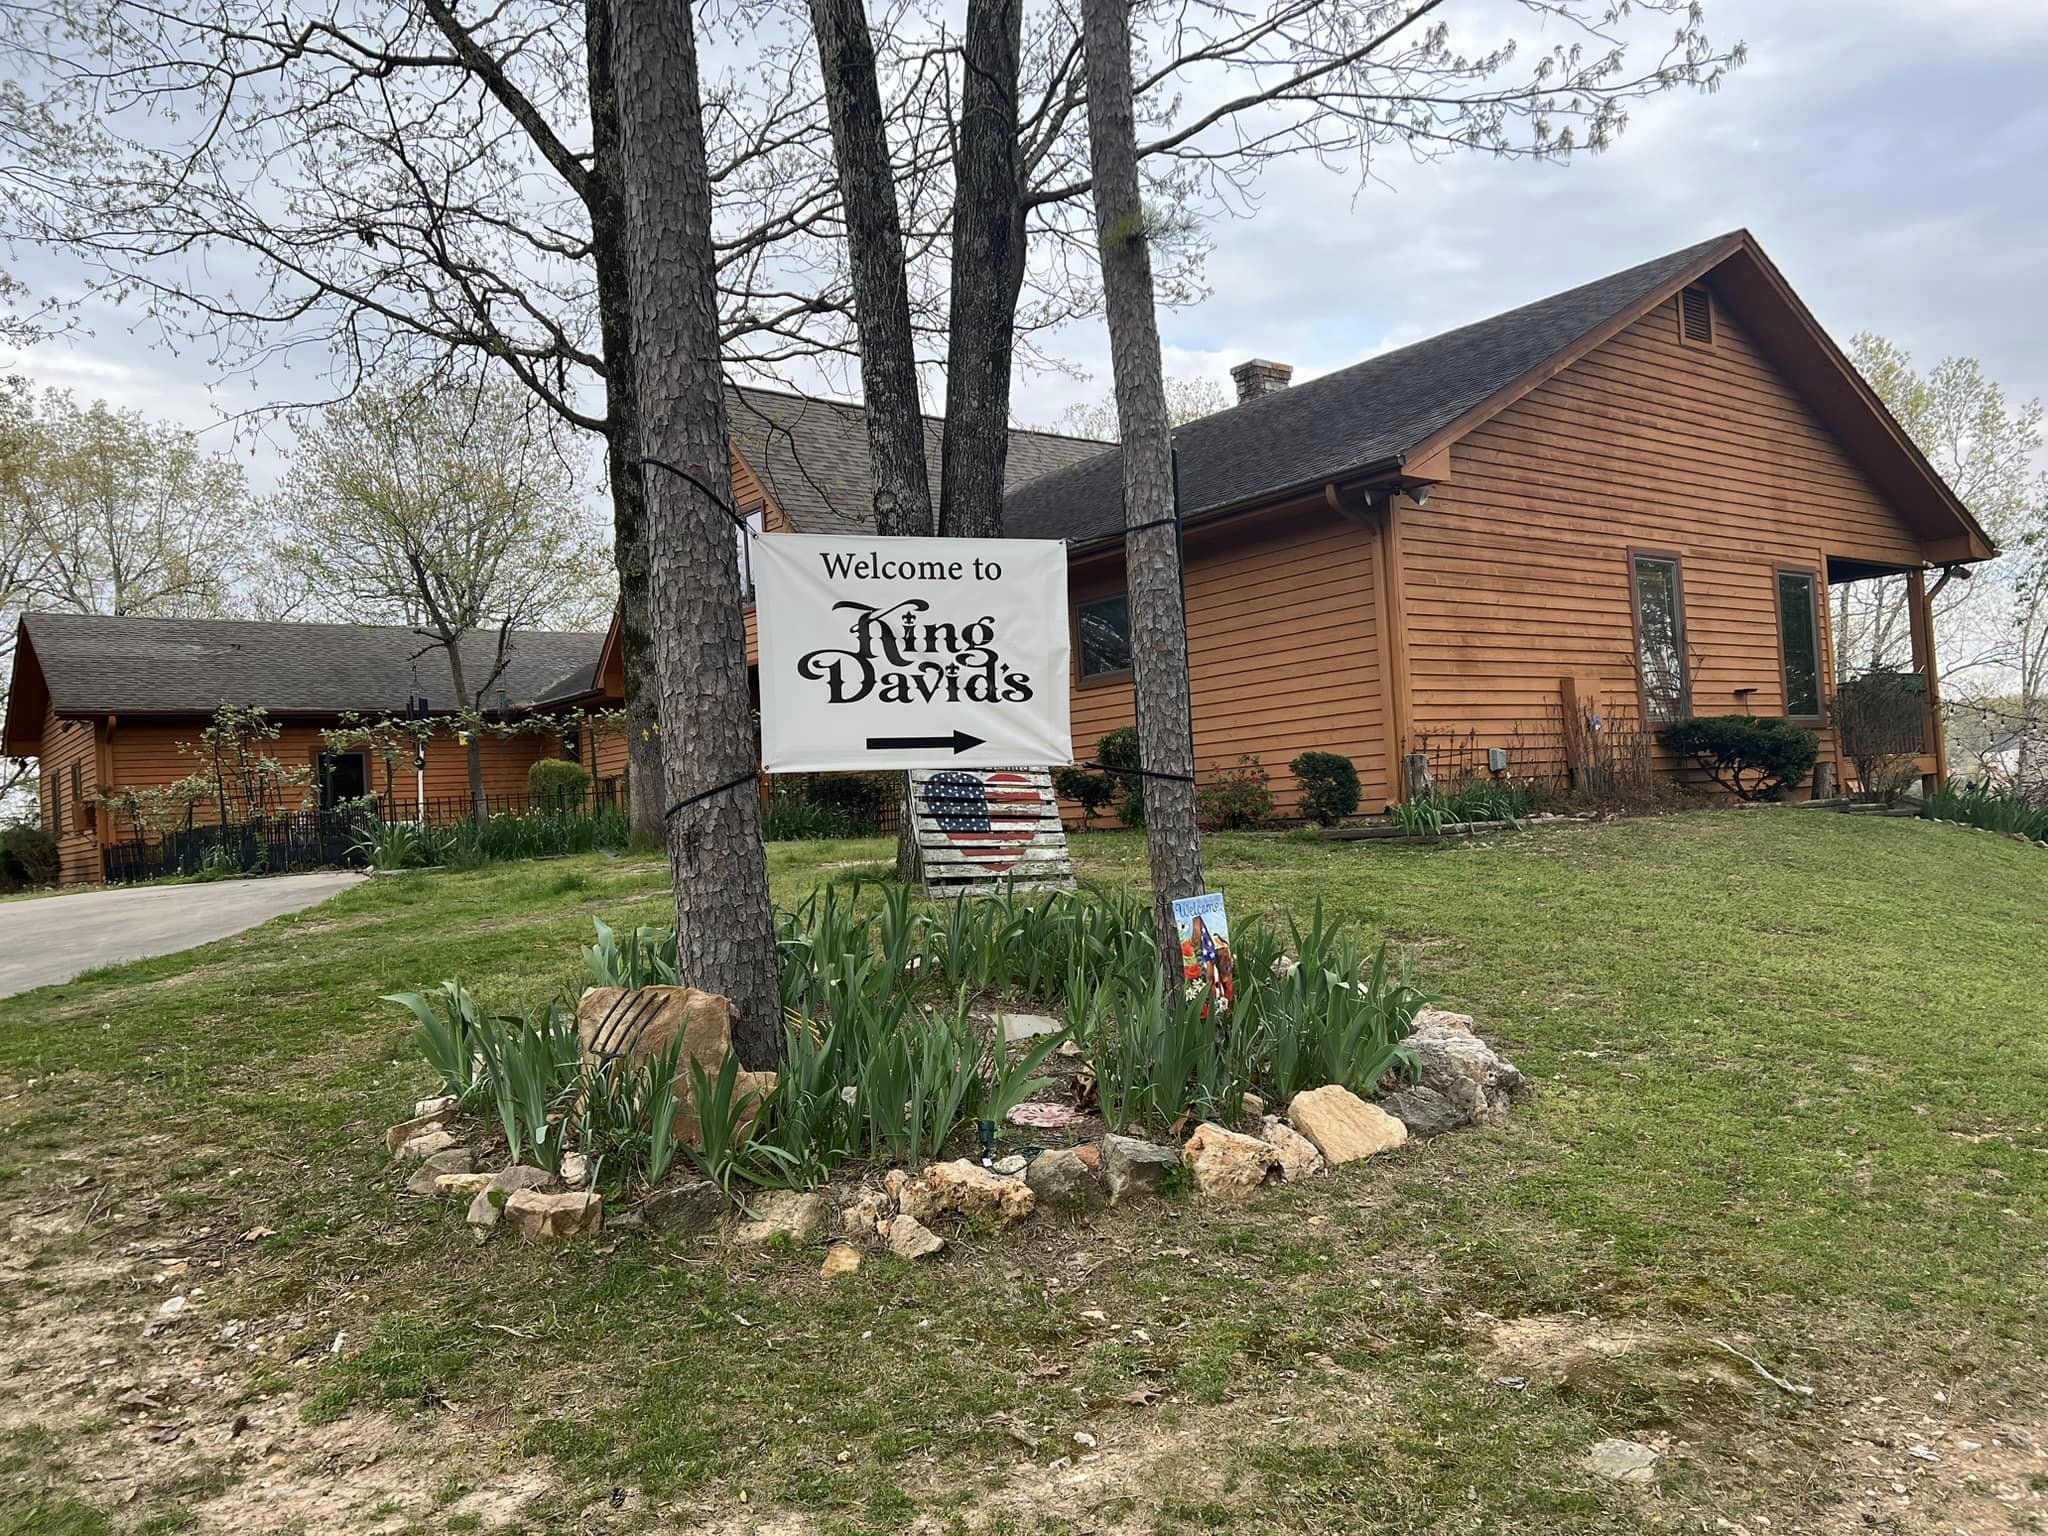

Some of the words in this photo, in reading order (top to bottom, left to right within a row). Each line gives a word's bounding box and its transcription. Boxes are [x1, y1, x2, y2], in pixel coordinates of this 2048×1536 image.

[819, 552, 962, 580] Welcome
[973, 557, 1003, 581] to
[832, 599, 998, 666] King
[797, 648, 1034, 703] David's
